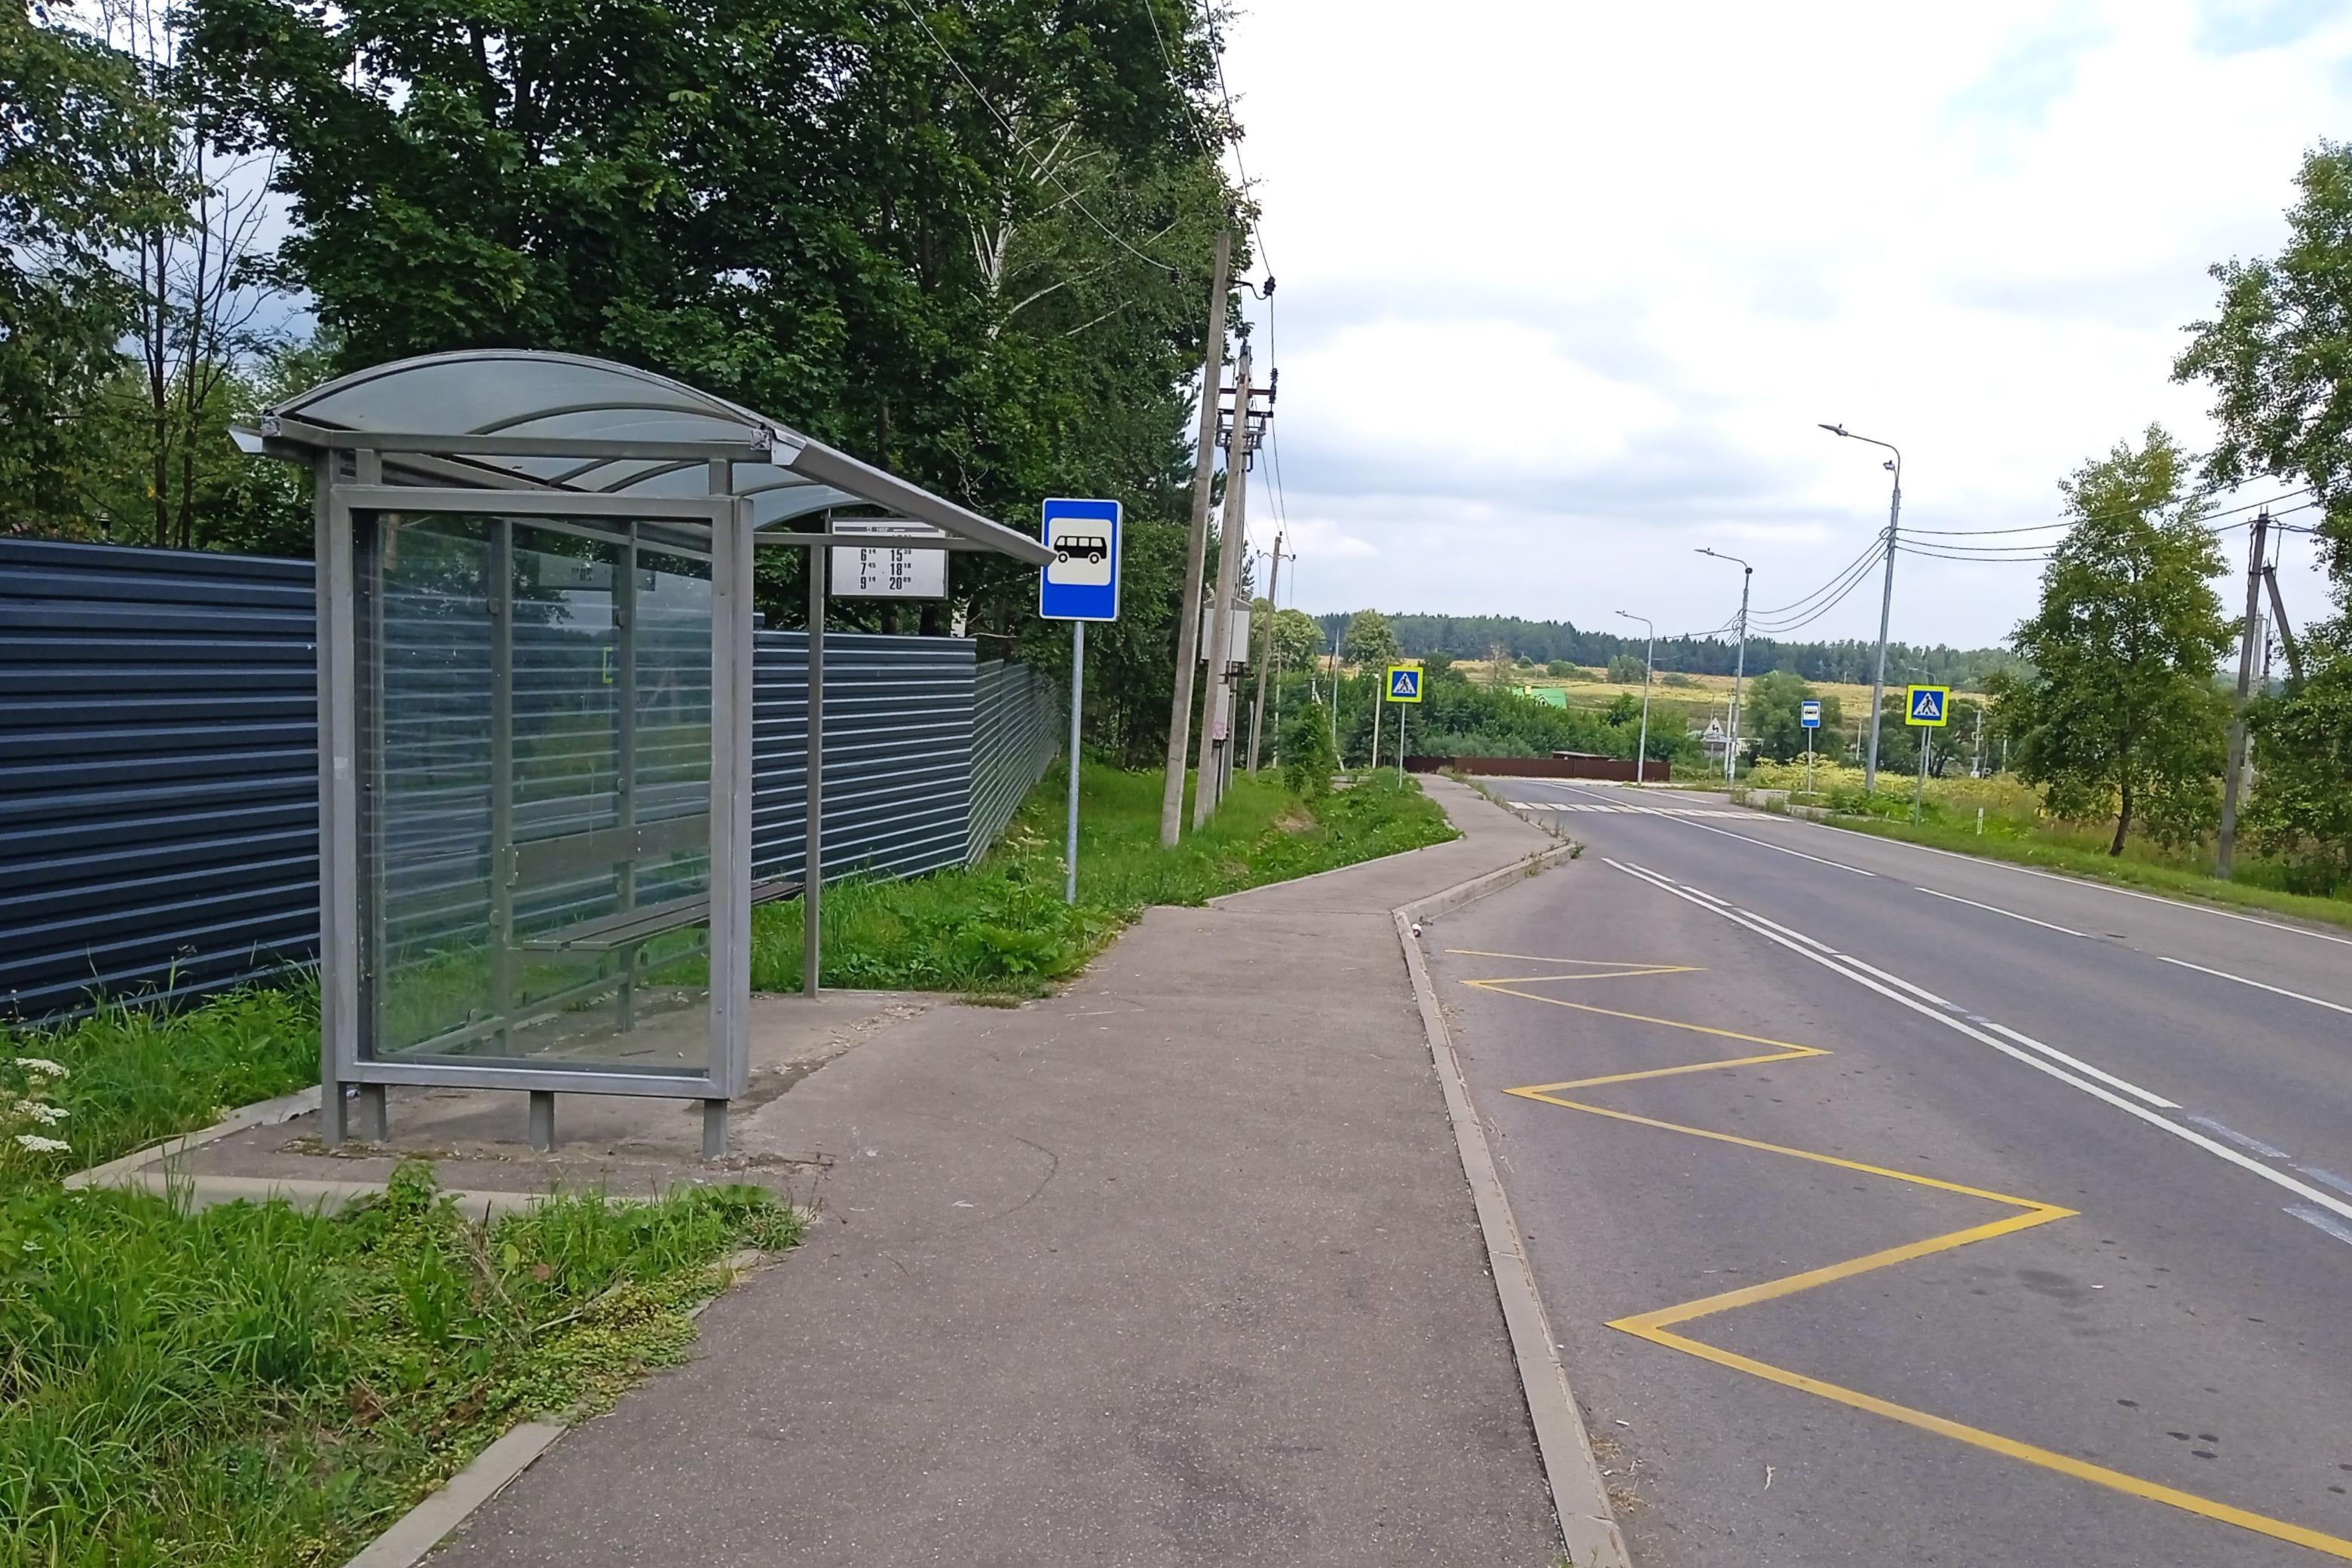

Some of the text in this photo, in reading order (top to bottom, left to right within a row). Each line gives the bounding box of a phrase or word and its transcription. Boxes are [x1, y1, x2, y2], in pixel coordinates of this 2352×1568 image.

[861, 549, 867, 562] 6
[890, 549, 902, 562] 15
[860, 562, 866, 575] 7
[890, 562, 902, 576] 18
[861, 576, 866, 590] 9
[890, 577, 902, 590] 20
